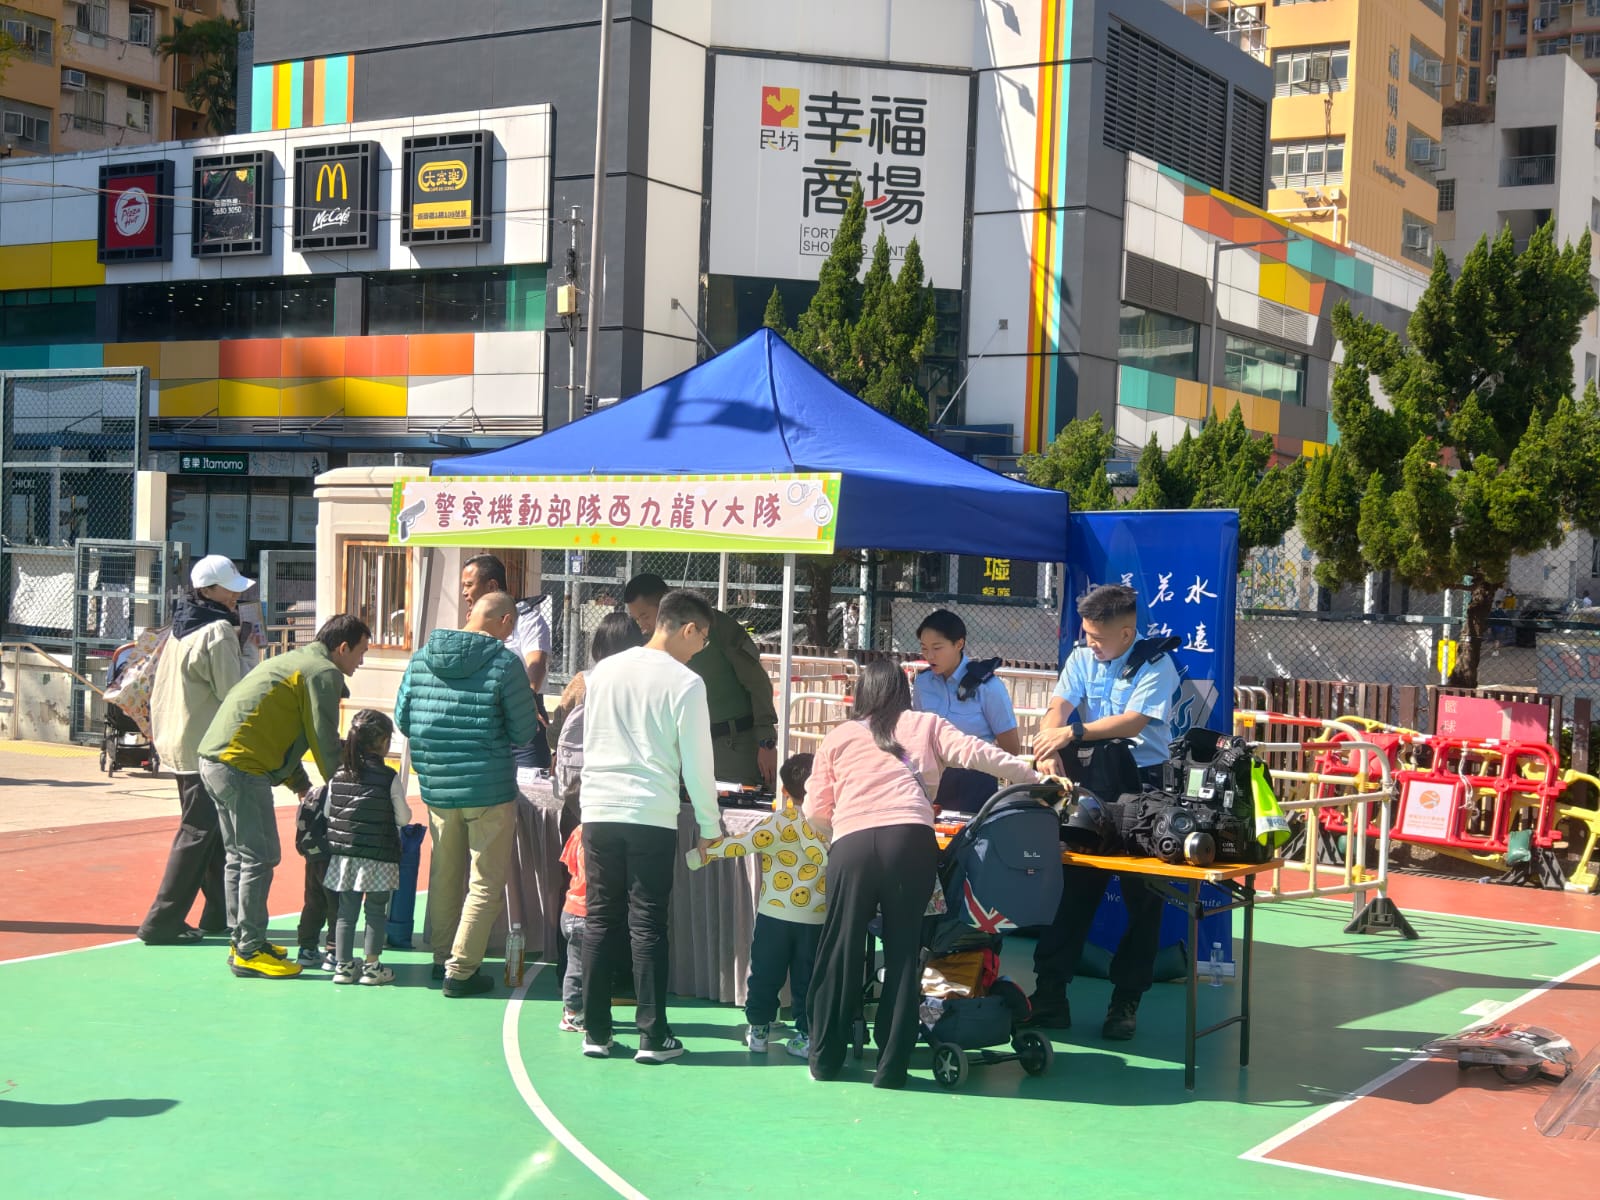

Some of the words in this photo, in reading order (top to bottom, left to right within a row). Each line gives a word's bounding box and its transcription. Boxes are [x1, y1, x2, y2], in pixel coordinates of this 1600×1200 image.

[804, 90, 928, 157] 幸福
[760, 129, 799, 151] 民坊
[802, 158, 926, 225] 商場
[121, 207, 141, 221] Pizza
[124, 215, 139, 229] Hut
[803, 226, 838, 240] FORT
[803, 240, 868, 256] SHOG
[203, 457, 244, 470] Itamomo
